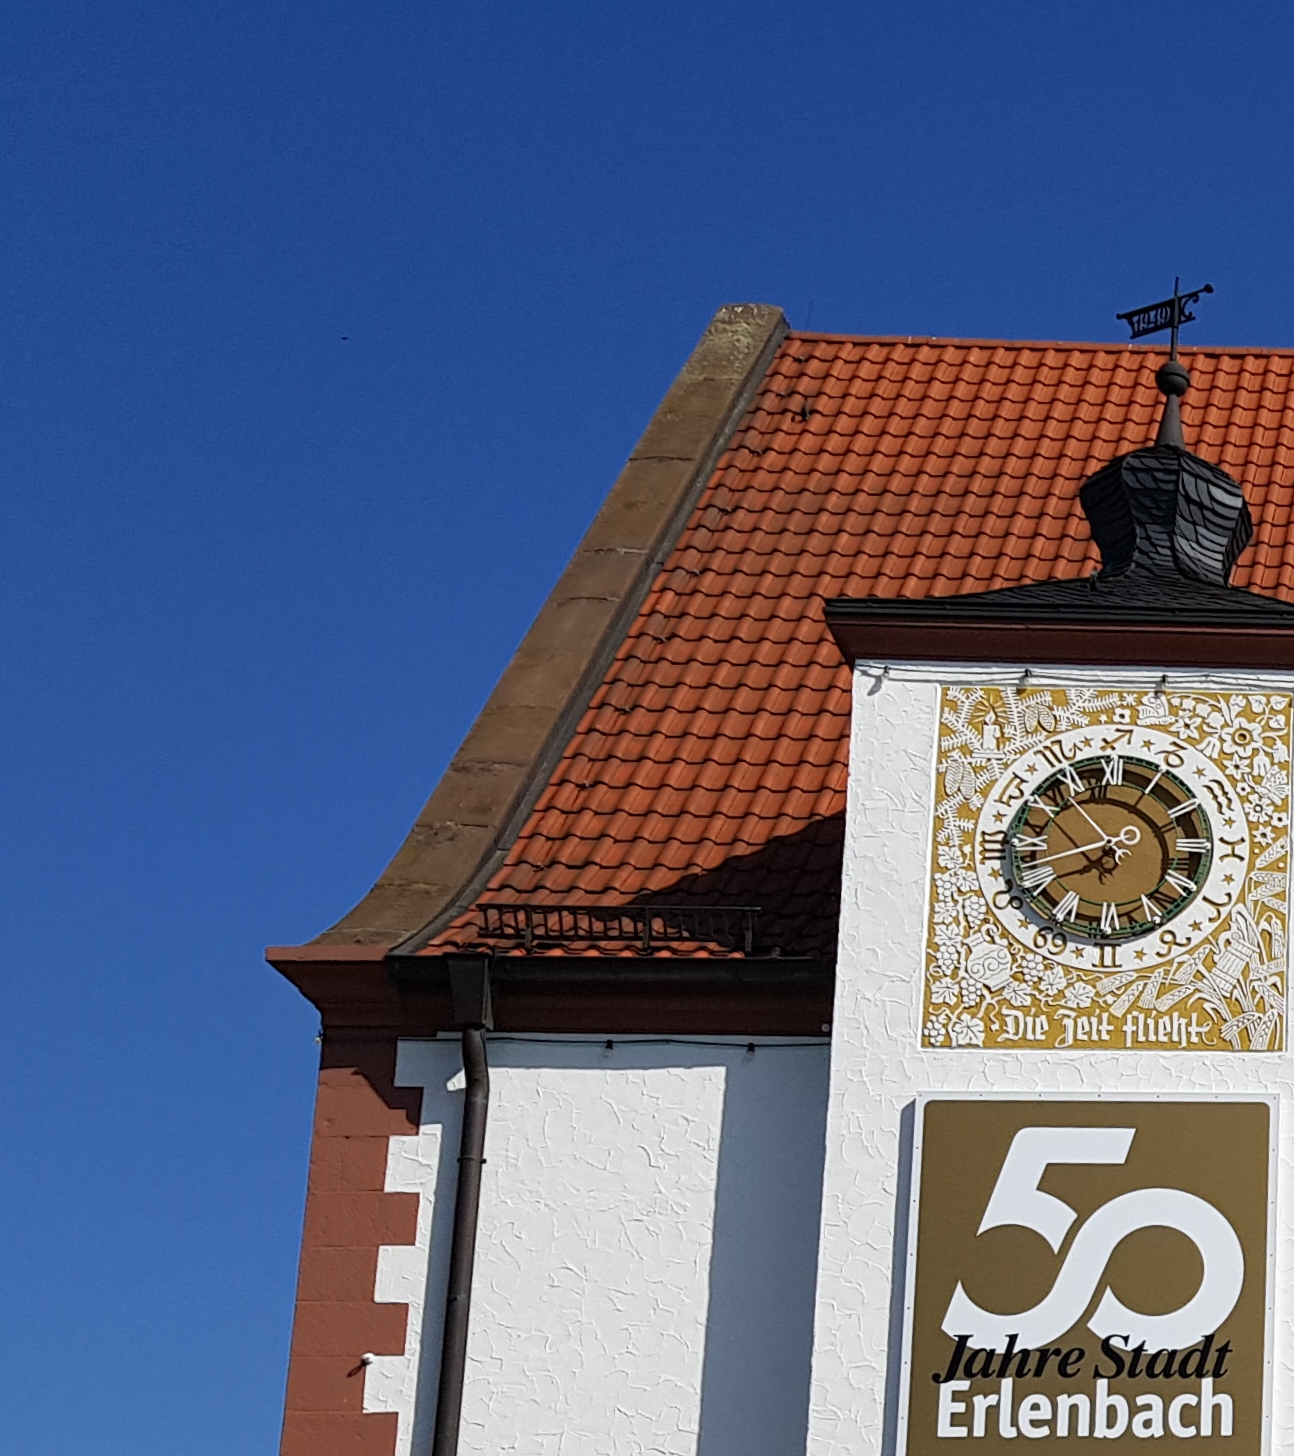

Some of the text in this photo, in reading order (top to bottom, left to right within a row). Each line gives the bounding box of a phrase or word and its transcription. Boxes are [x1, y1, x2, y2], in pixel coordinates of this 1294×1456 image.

[1100, 758, 1124, 787] XII
[996, 1005, 1049, 1042] Die
[1054, 1008, 1114, 1048] Zeit
[941, 1127, 1245, 1354] 50
[932, 1334, 1233, 1384] Jahre Stadt
[936, 1377, 1234, 1439] Erlenbach
